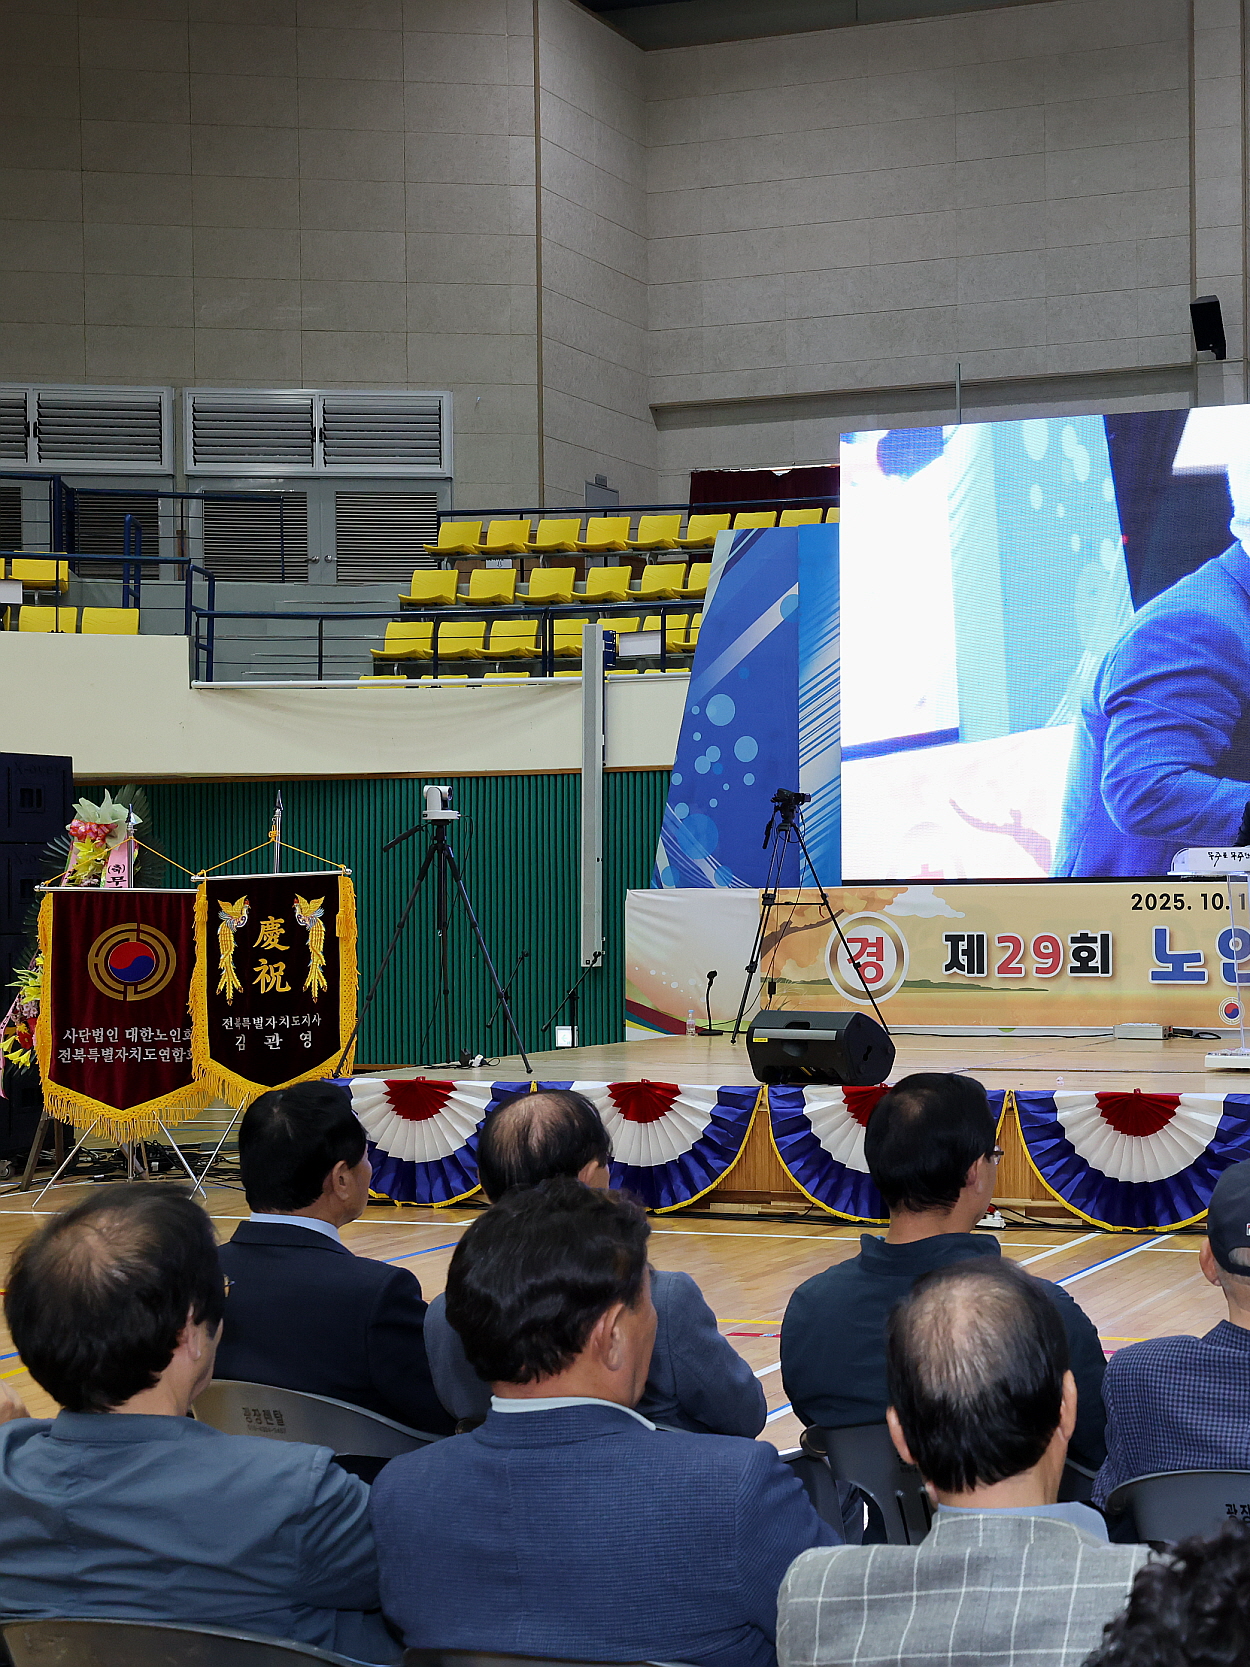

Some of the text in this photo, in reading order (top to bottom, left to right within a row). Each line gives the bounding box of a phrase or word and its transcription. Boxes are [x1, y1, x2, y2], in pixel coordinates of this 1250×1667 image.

[1131, 893, 1192, 911] 2025.
[1200, 893, 1230, 911] 10.
[252, 915, 292, 994] 慶祝
[846, 936, 884, 984] 경
[942, 931, 1113, 977] 제29회
[62, 1027, 119, 1044] 사단법인
[222, 1013, 322, 1030] 전북특별자치도지사
